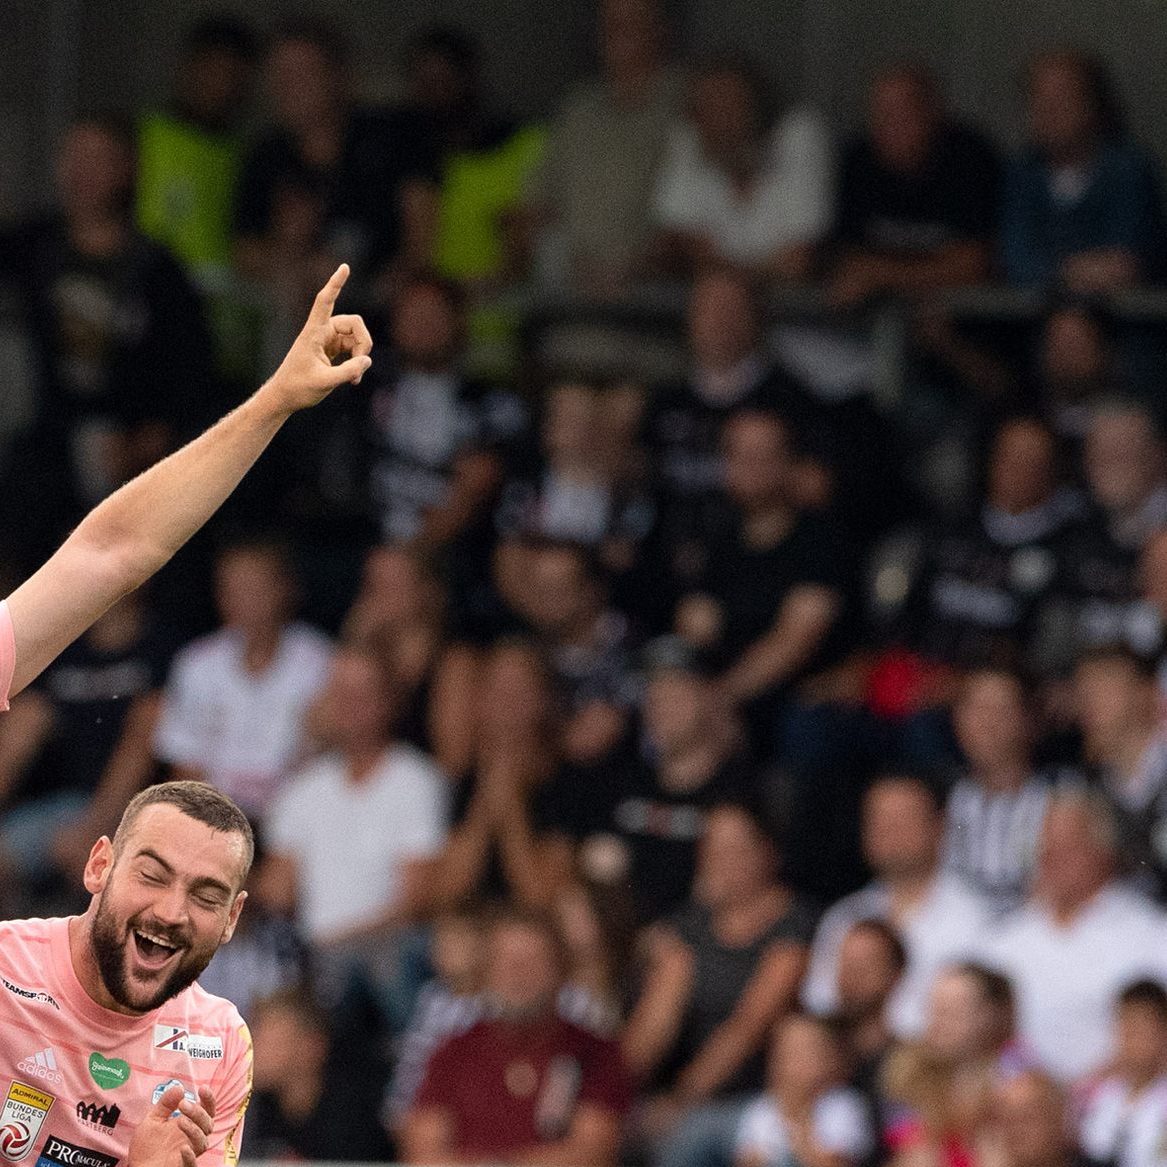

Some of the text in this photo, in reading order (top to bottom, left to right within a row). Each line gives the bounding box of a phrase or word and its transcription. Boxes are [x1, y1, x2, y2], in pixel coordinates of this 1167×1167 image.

[17, 1060, 65, 1084] adidas
[12, 1088, 50, 1107] ADMIRAL
[6, 1100, 44, 1119] BUNDES
[11, 1110, 32, 1123] LIGA
